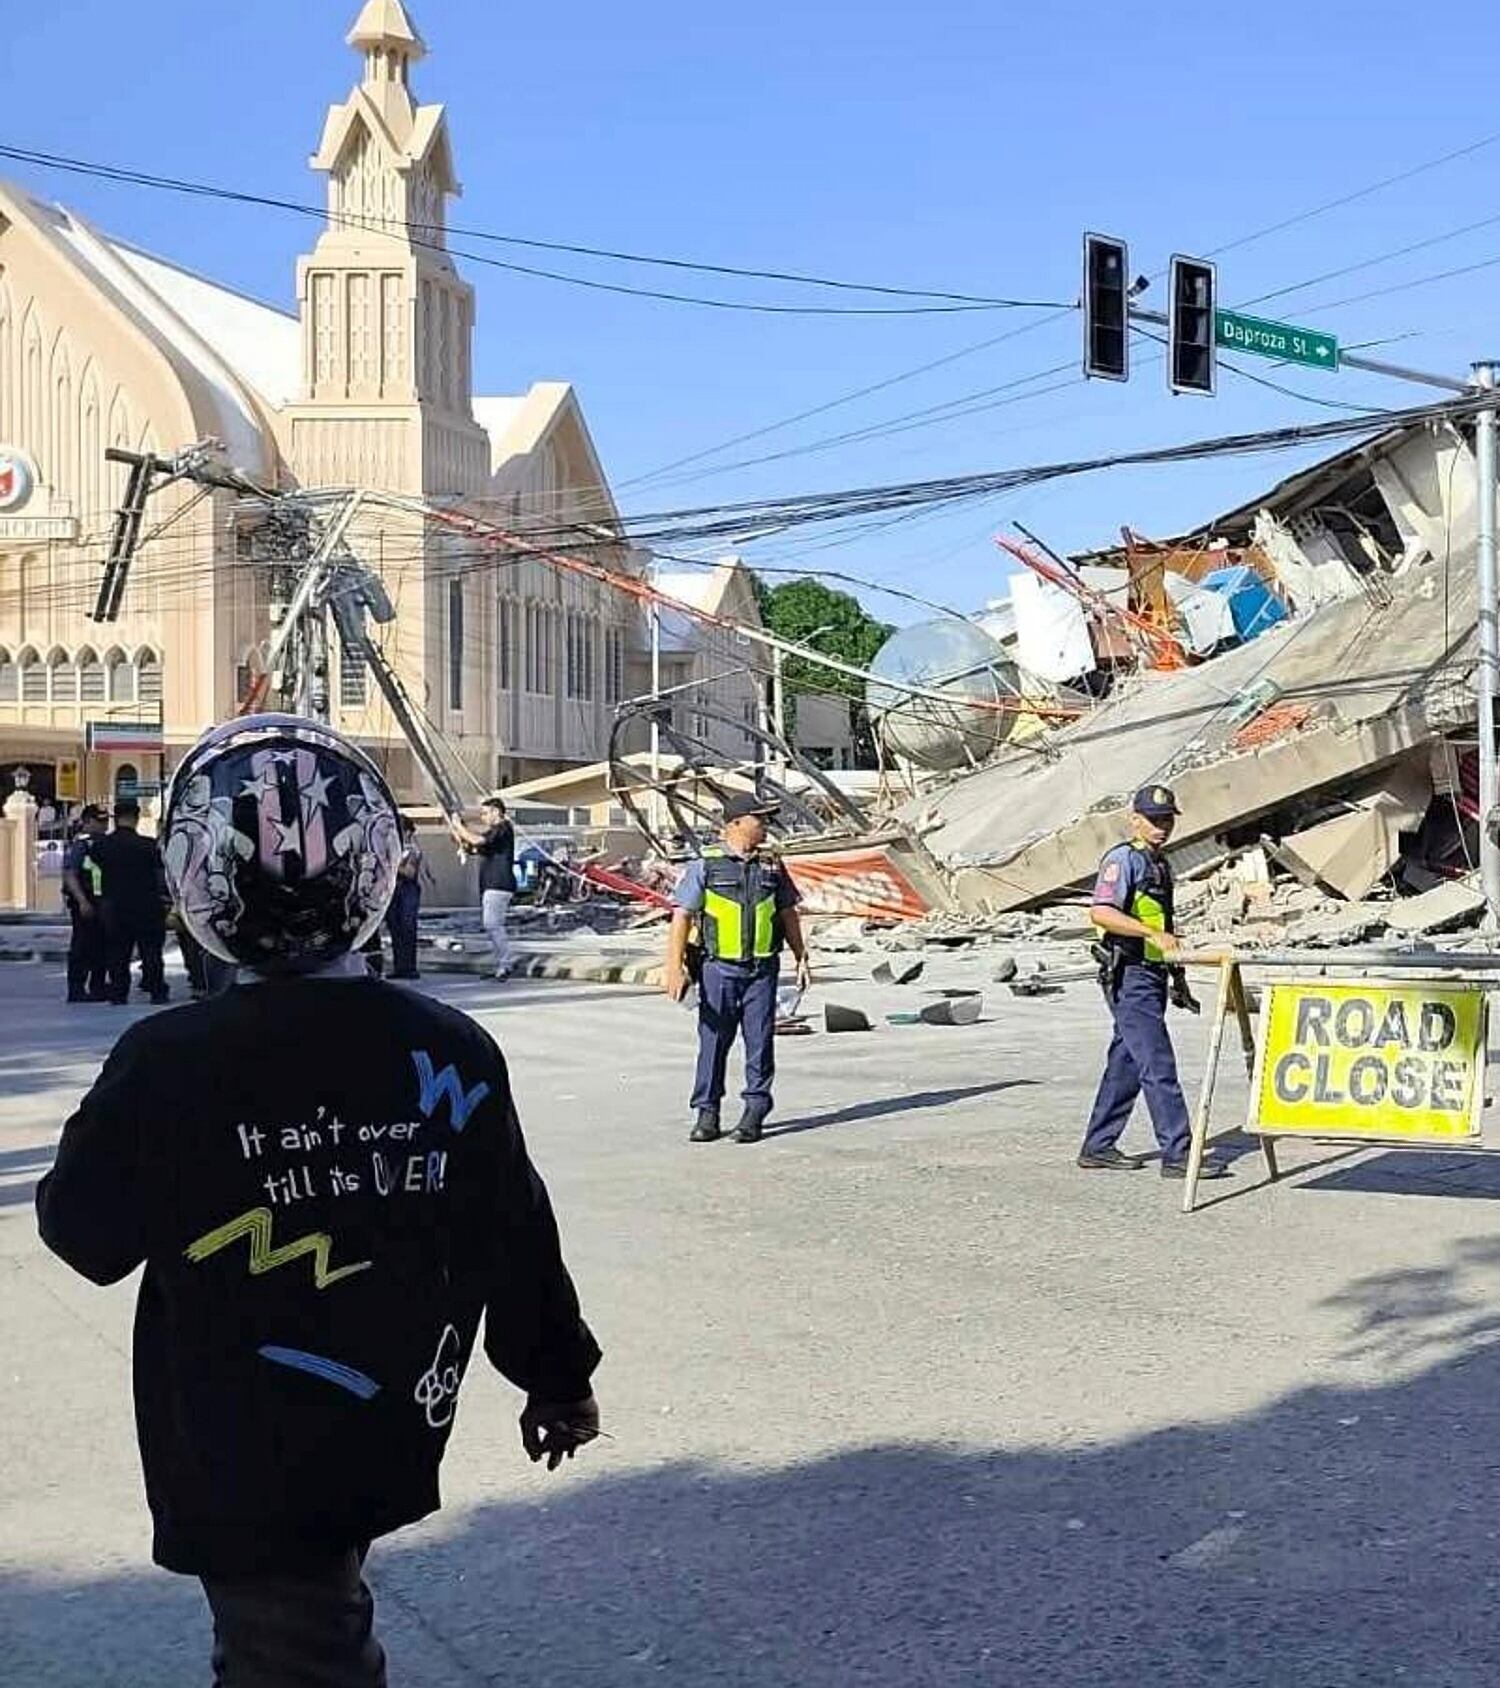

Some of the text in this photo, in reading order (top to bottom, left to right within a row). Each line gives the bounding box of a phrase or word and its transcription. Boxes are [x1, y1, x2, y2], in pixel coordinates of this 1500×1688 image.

[1223, 321, 1286, 350] Daproza
[1295, 997, 1456, 1051] ROAD
[1274, 1052, 1468, 1111] CLOSE
[237, 1106, 421, 1159] It ain't over
[263, 1166, 317, 1204] till
[329, 1165, 360, 1197] its
